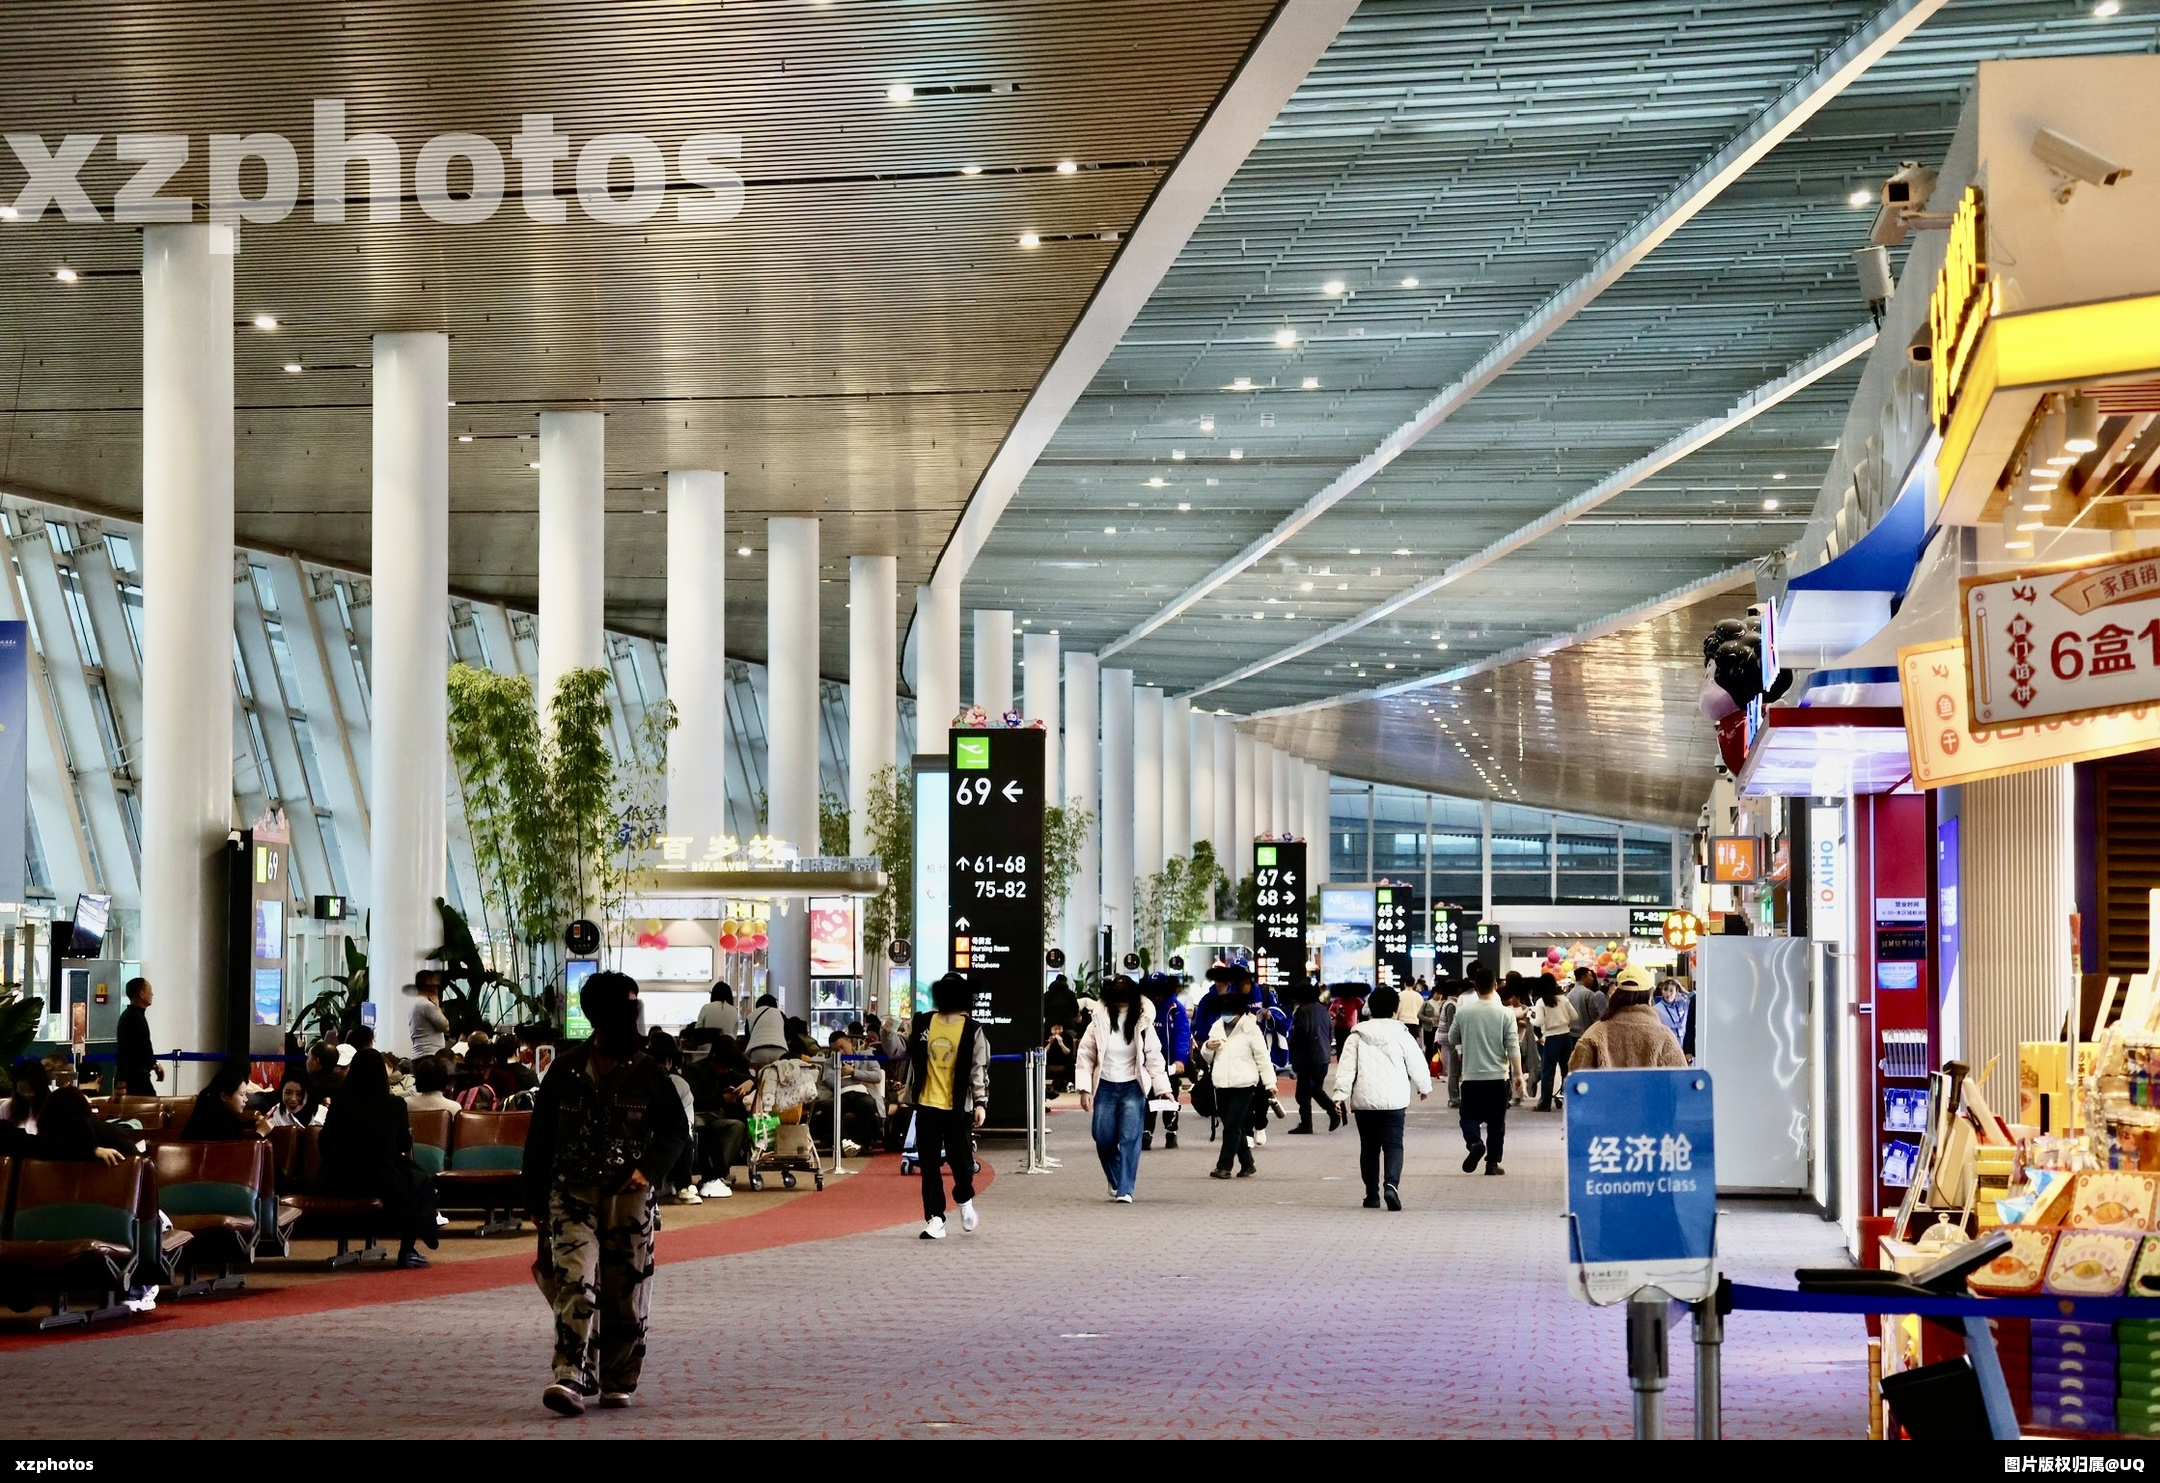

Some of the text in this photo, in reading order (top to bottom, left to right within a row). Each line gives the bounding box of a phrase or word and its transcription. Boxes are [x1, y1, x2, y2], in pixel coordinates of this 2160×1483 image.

[2082, 563, 2158, 608] 厂家直销
[2012, 619, 2032, 702] 厦门馅饼
[1938, 697, 1958, 752] 鱼干
[956, 777, 992, 805] 69
[655, 835, 787, 861] 百岁坊
[267, 851, 279, 880] 69
[974, 856, 1026, 873] 61-68
[1257, 869, 1279, 886] 67
[1820, 840, 1834, 909] OHIYO!
[974, 881, 1026, 898] 75-82
[1257, 889, 1279, 906] 68
[1268, 913, 1299, 924] 61-66
[1377, 904, 1393, 917] 65
[1633, 911, 1659, 922] 75-82
[1268, 927, 1299, 938] 75-82
[1377, 918, 1393, 931] 66
[971, 945, 993, 954] Nursing
[995, 1016, 1012, 1024] Water
[1588, 1133, 1692, 1174] 经济舱
[1586, 1178, 1696, 1197] Economy Class
